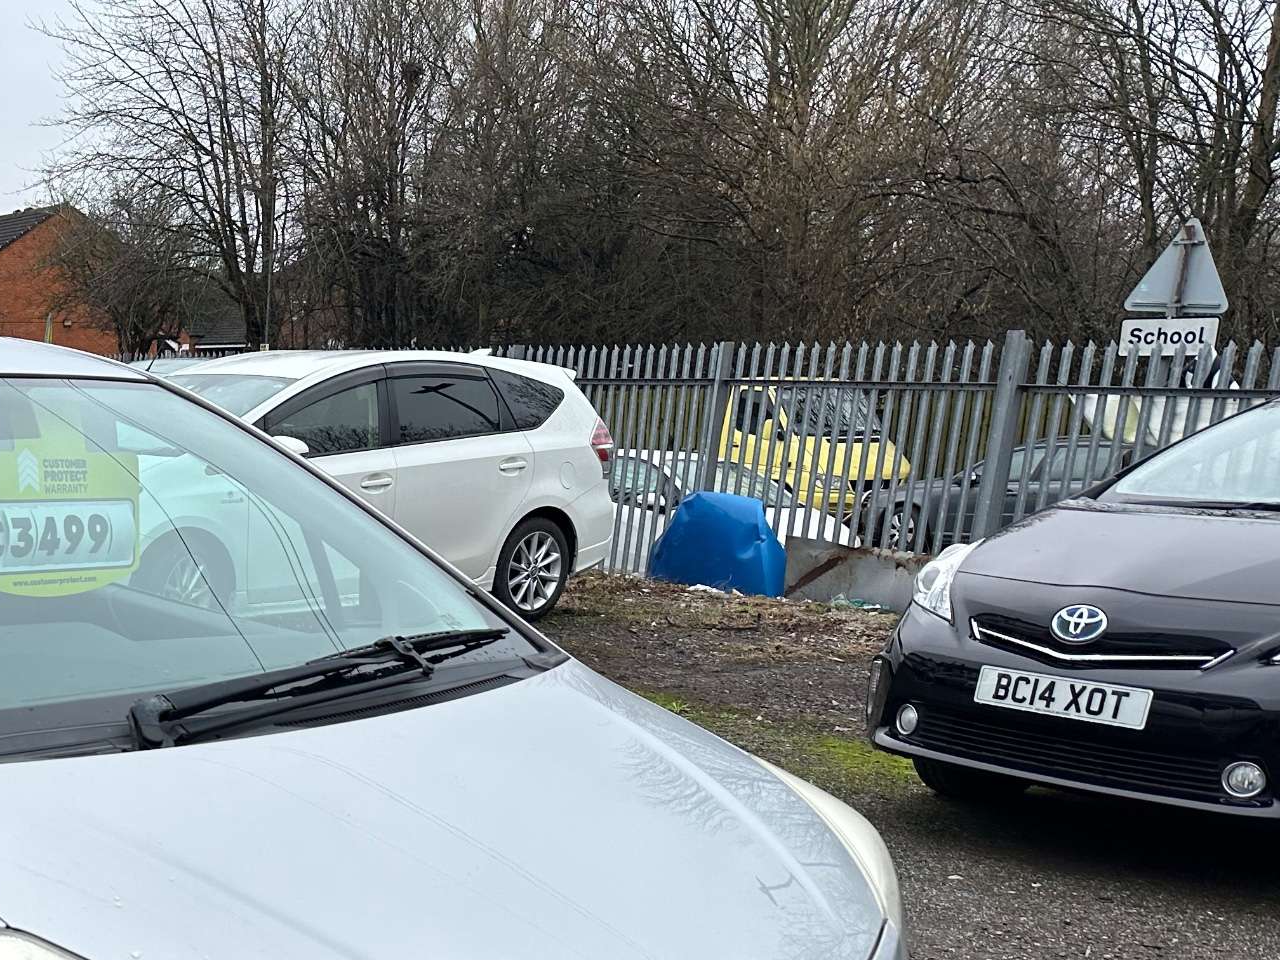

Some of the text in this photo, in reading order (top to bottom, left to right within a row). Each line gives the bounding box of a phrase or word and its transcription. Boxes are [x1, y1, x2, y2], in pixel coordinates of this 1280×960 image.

[1128, 327, 1204, 344] School
[42, 458, 88, 469] CUSTOMER
[43, 470, 88, 482] PROTECT
[44, 484, 89, 494] WARRANTY
[992, 672, 1130, 719] BC14 XOT
